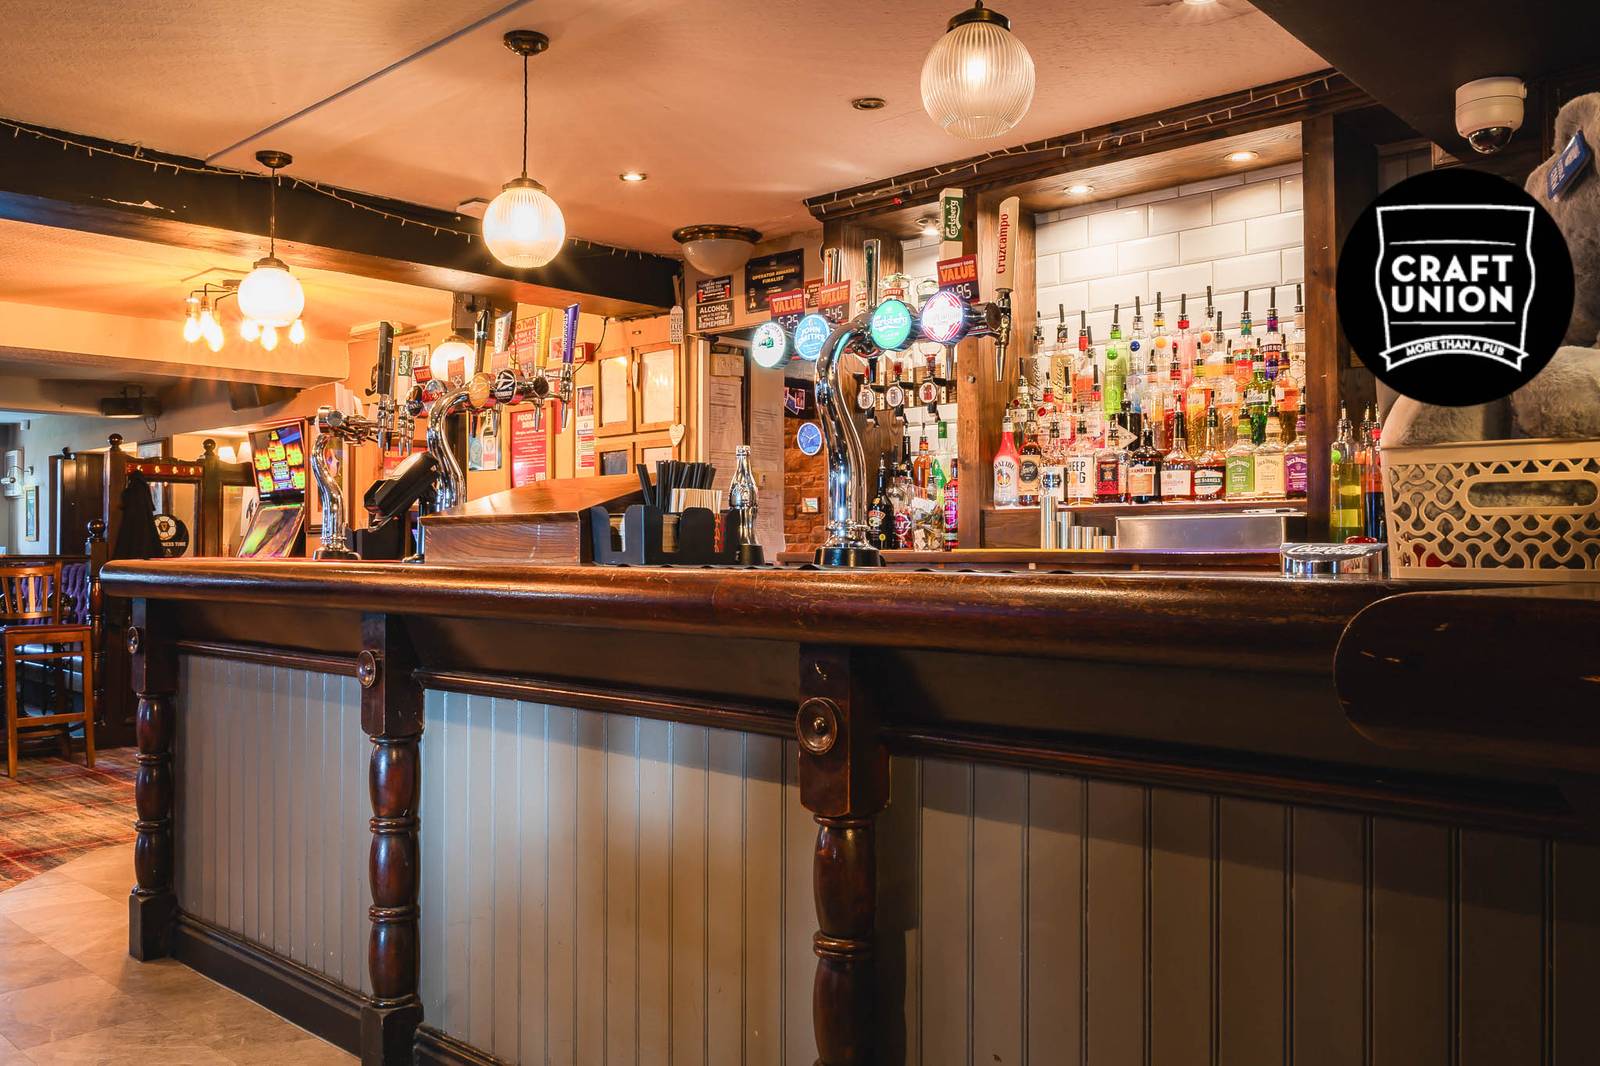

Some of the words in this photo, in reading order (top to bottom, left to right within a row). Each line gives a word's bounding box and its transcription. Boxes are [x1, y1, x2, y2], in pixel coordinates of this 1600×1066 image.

[945, 199, 961, 239] Carlsberg
[997, 213, 1010, 274] Cruzcampo
[940, 265, 976, 282] VALUE
[820, 288, 848, 305] VALUE
[700, 304, 729, 314] ALCOHOL
[773, 299, 803, 313] VALUE
[802, 327, 821, 335] JOHN
